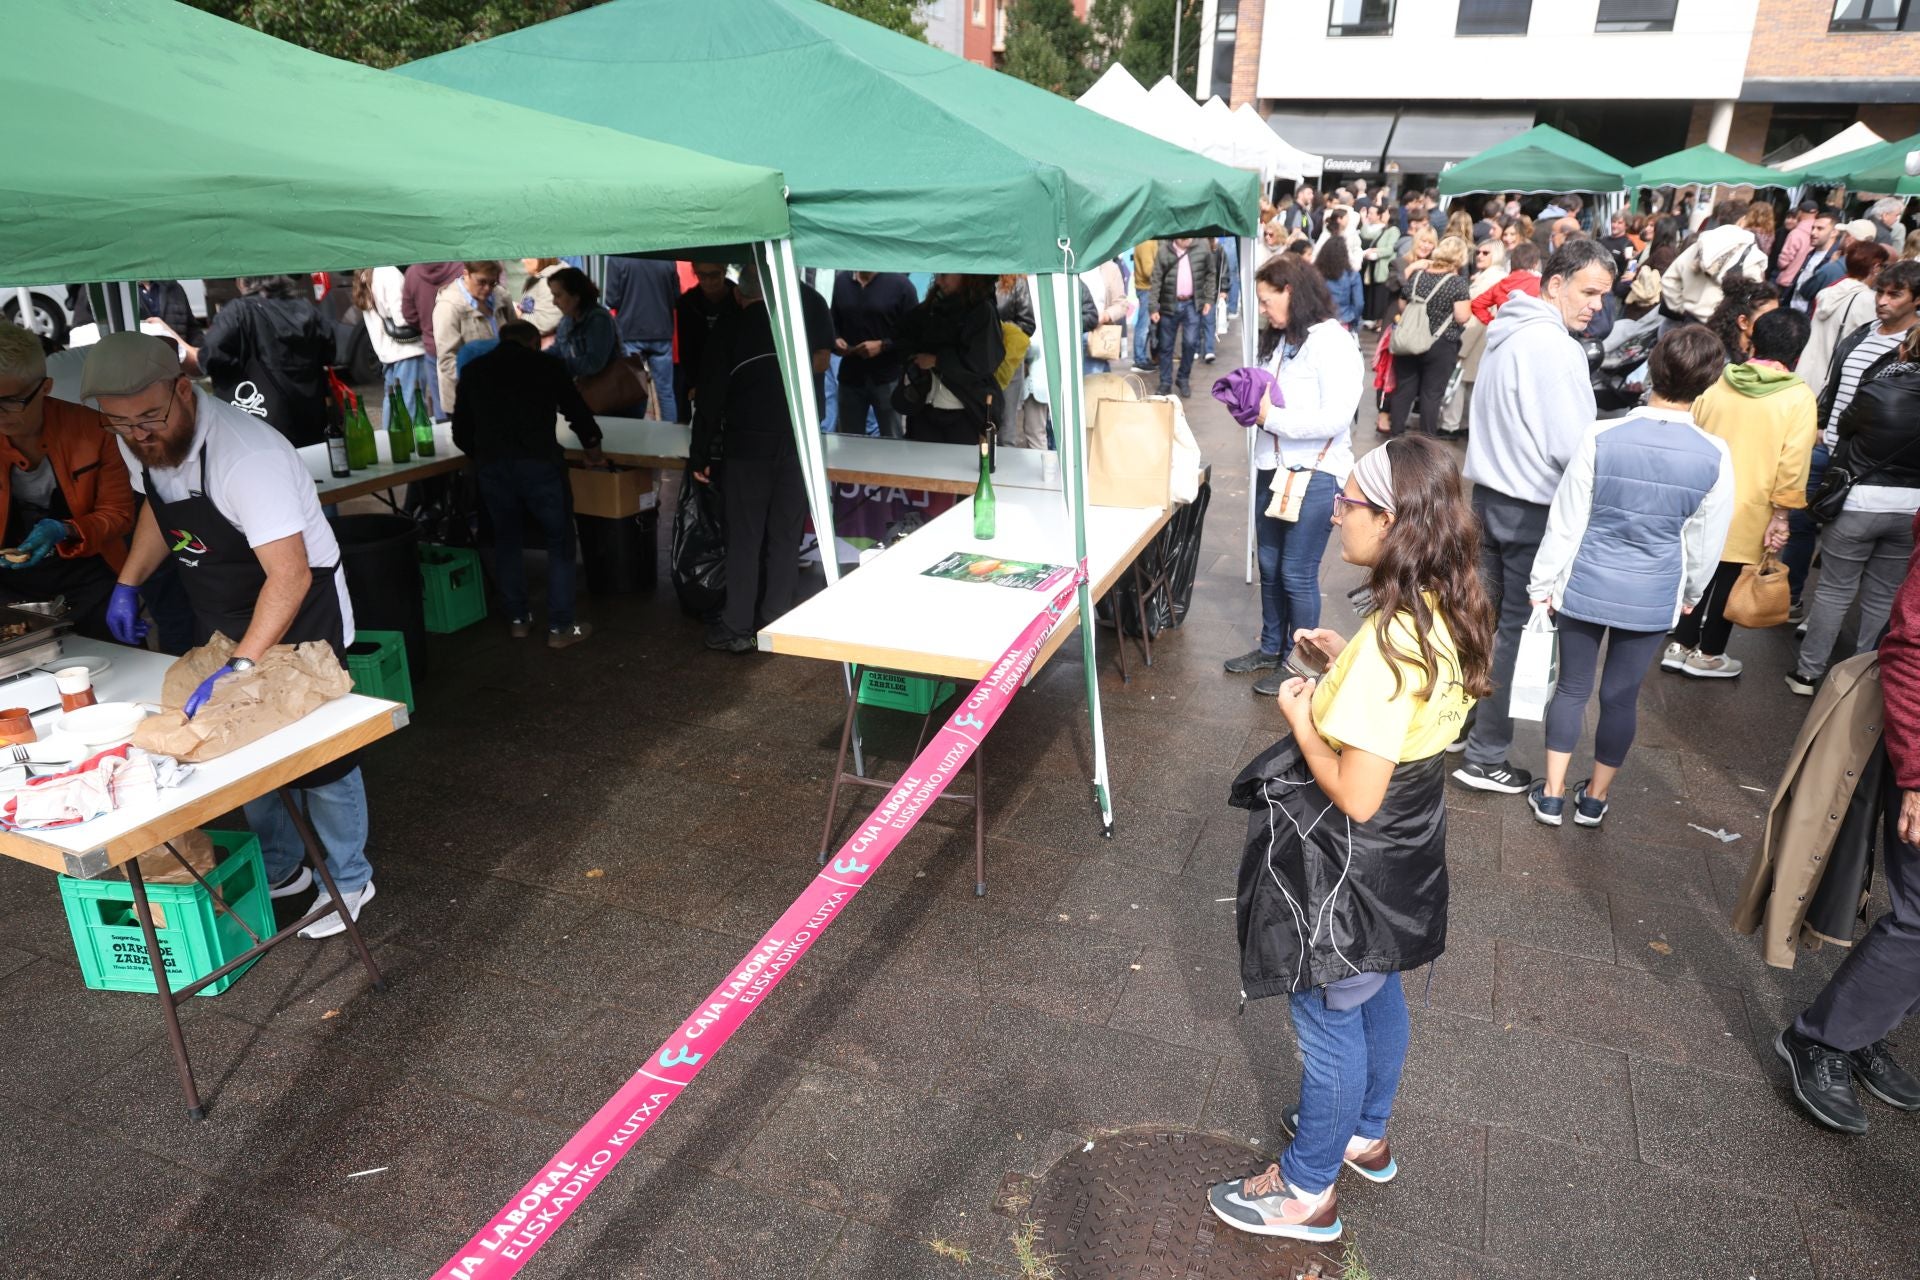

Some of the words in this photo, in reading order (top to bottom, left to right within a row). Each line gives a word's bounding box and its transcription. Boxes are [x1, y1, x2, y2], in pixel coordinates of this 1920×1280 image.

[968, 686, 992, 709] CAJA
[985, 649, 1022, 686] LABORAL
[1000, 647, 1037, 695] EUSKADIKO
[852, 825, 882, 853] CAJA
[876, 776, 922, 825] LABORAL
[892, 774, 943, 829] EUSKADIKO
[937, 741, 968, 774] KUTXA
[685, 1002, 728, 1039] CAJA
[720, 938, 785, 1000] LABORAL
[739, 931, 811, 1003] EUSKADIKO
[806, 891, 848, 929] KUTXA
[480, 1159, 578, 1251] LABORAL
[502, 1149, 612, 1260] EUSKADIKO
[608, 1091, 669, 1146] KUTXA
